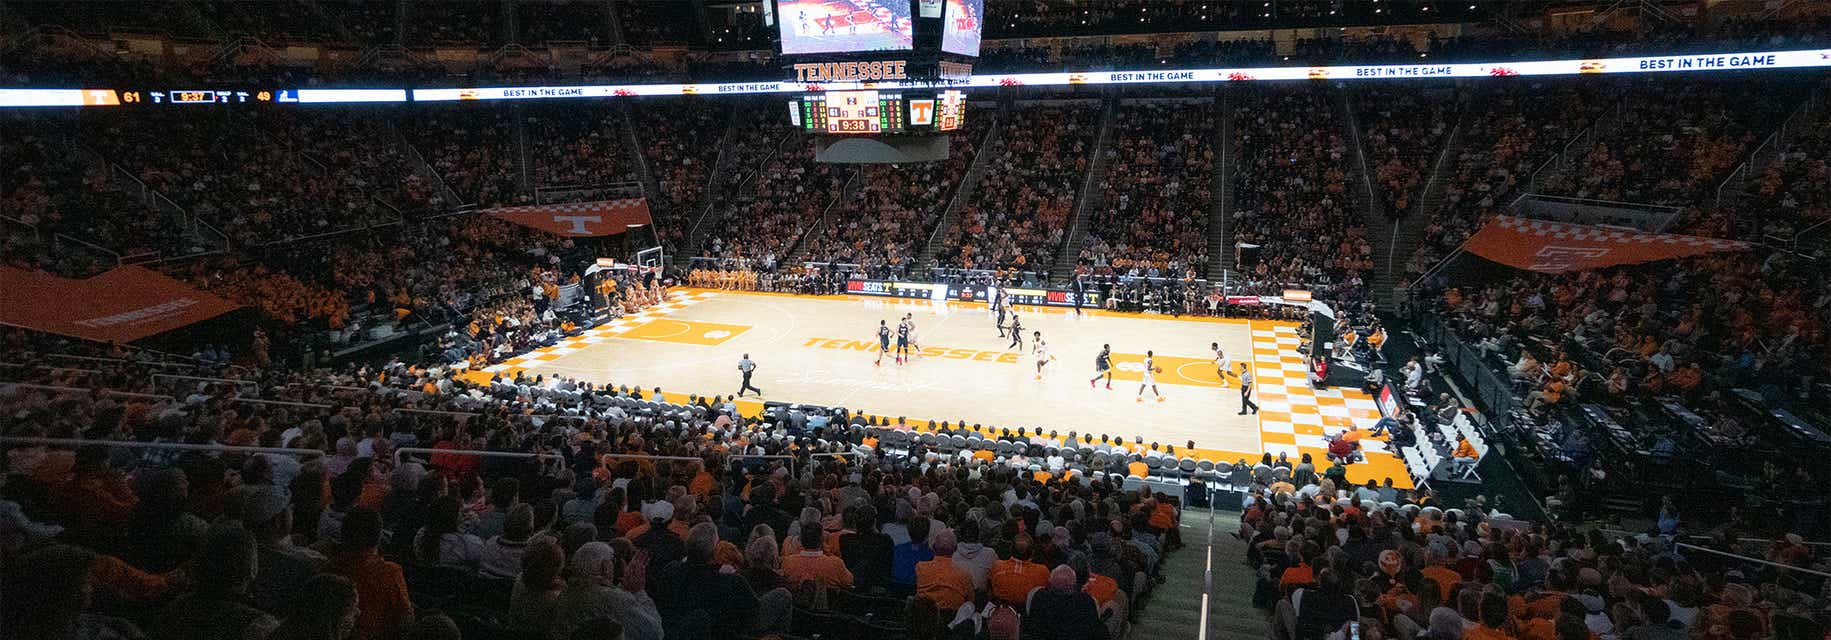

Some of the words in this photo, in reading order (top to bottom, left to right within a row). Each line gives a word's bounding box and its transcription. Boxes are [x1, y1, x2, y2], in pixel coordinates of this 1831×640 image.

[1640, 59, 1674, 69] BEST
[1679, 58, 1692, 68] IN
[1697, 57, 1724, 67] THE
[1729, 55, 1776, 66] GAME
[794, 60, 906, 81] TENNESSEE
[1356, 68, 1382, 76] BEST
[1399, 67, 1418, 75] THE
[1421, 66, 1452, 75] GAME
[1111, 73, 1133, 81] BEST
[1135, 73, 1144, 81] IN
[1167, 72, 1193, 80] GAME
[123, 91, 140, 102] 61
[503, 89, 525, 97] BEST
[558, 88, 583, 96] GAME
[912, 102, 932, 122] T
[842, 120, 866, 130] 9:38
[554, 215, 602, 235] T
